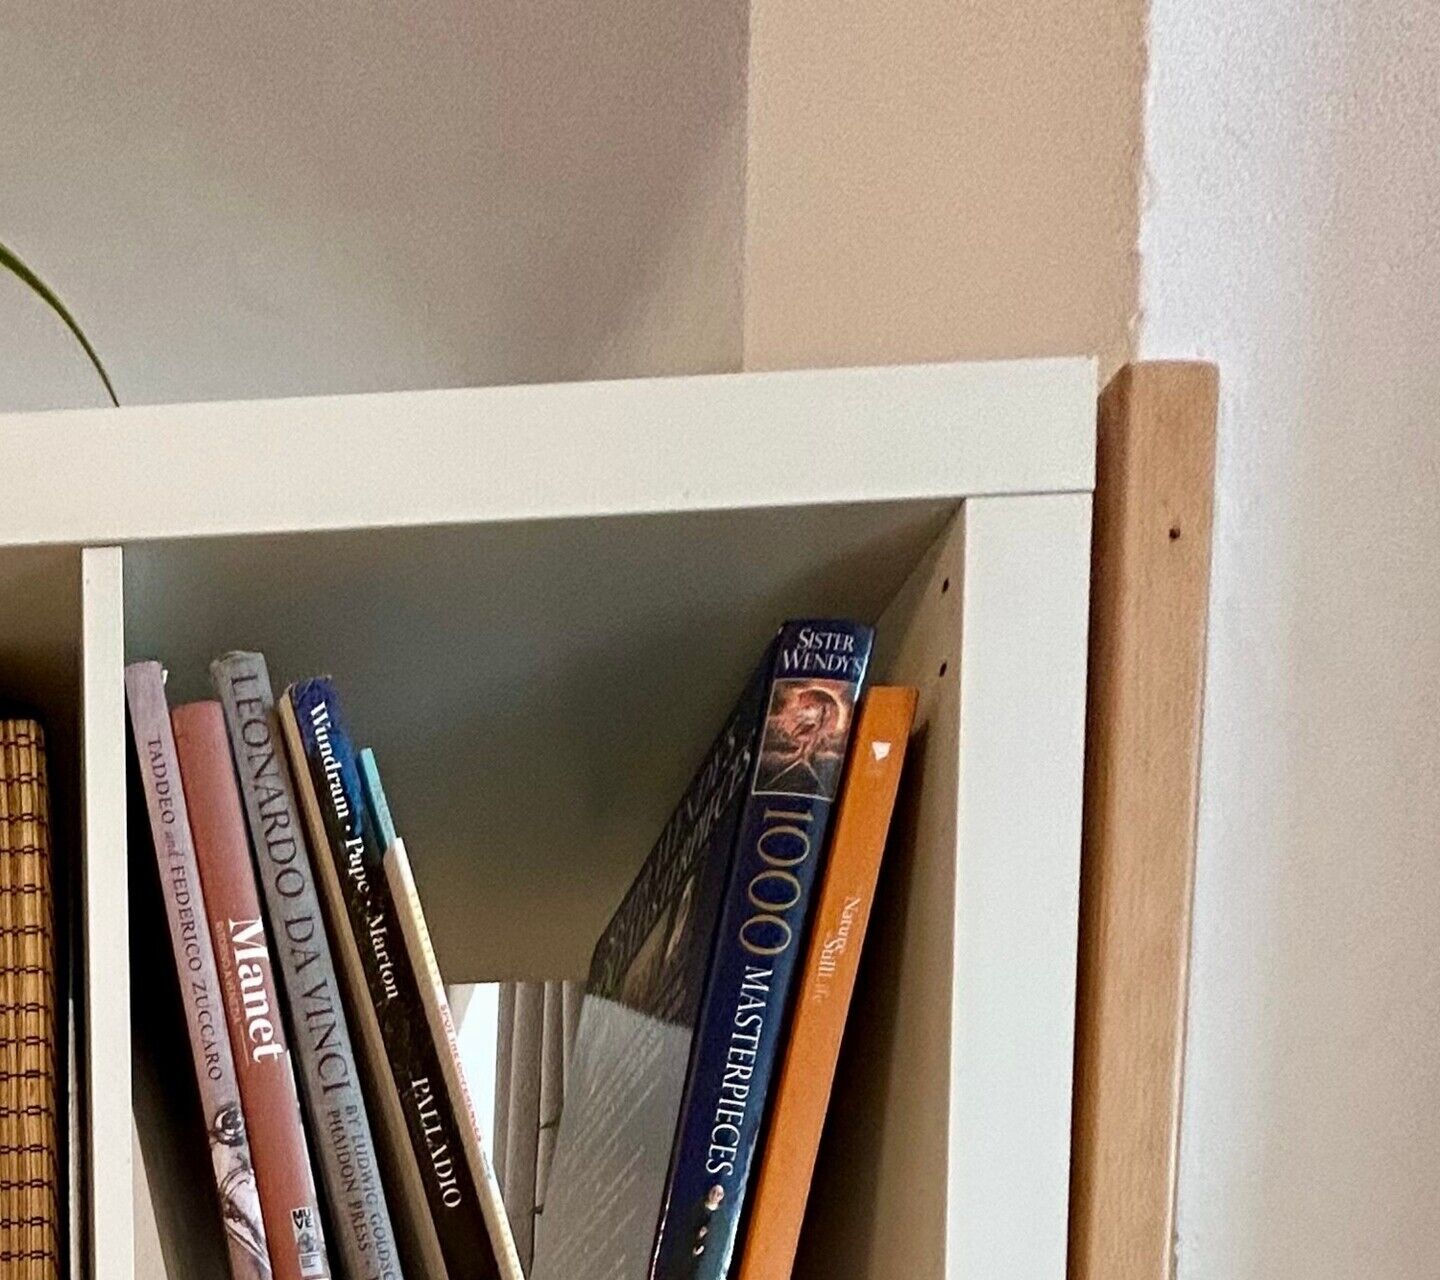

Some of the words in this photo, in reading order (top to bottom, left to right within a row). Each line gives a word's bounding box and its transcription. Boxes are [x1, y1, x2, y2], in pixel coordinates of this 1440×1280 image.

[797, 628, 854, 652] SISTER
[147, 736, 175, 824] TADDEO
[230, 671, 307, 901] LEONARDO
[164, 831, 183, 857] and
[307, 701, 355, 819] Wundram
[339, 836, 375, 895] Pape
[365, 913, 405, 999] Marton
[735, 804, 814, 959] 1000
[170, 865, 203, 971] FEDERICO
[283, 914, 323, 974] DA
[191, 980, 222, 1080] ZUCCARO
[227, 913, 287, 1064] Manet
[299, 980, 351, 1095] VINCI
[344, 1103, 361, 1126] BY
[705, 965, 772, 1176] MASTERPIECES
[326, 1107, 359, 1192] PHAIDON
[348, 1199, 372, 1252] PRESS
[351, 1133, 379, 1206] LUDWIG
[409, 1076, 464, 1210] PALLADIO
